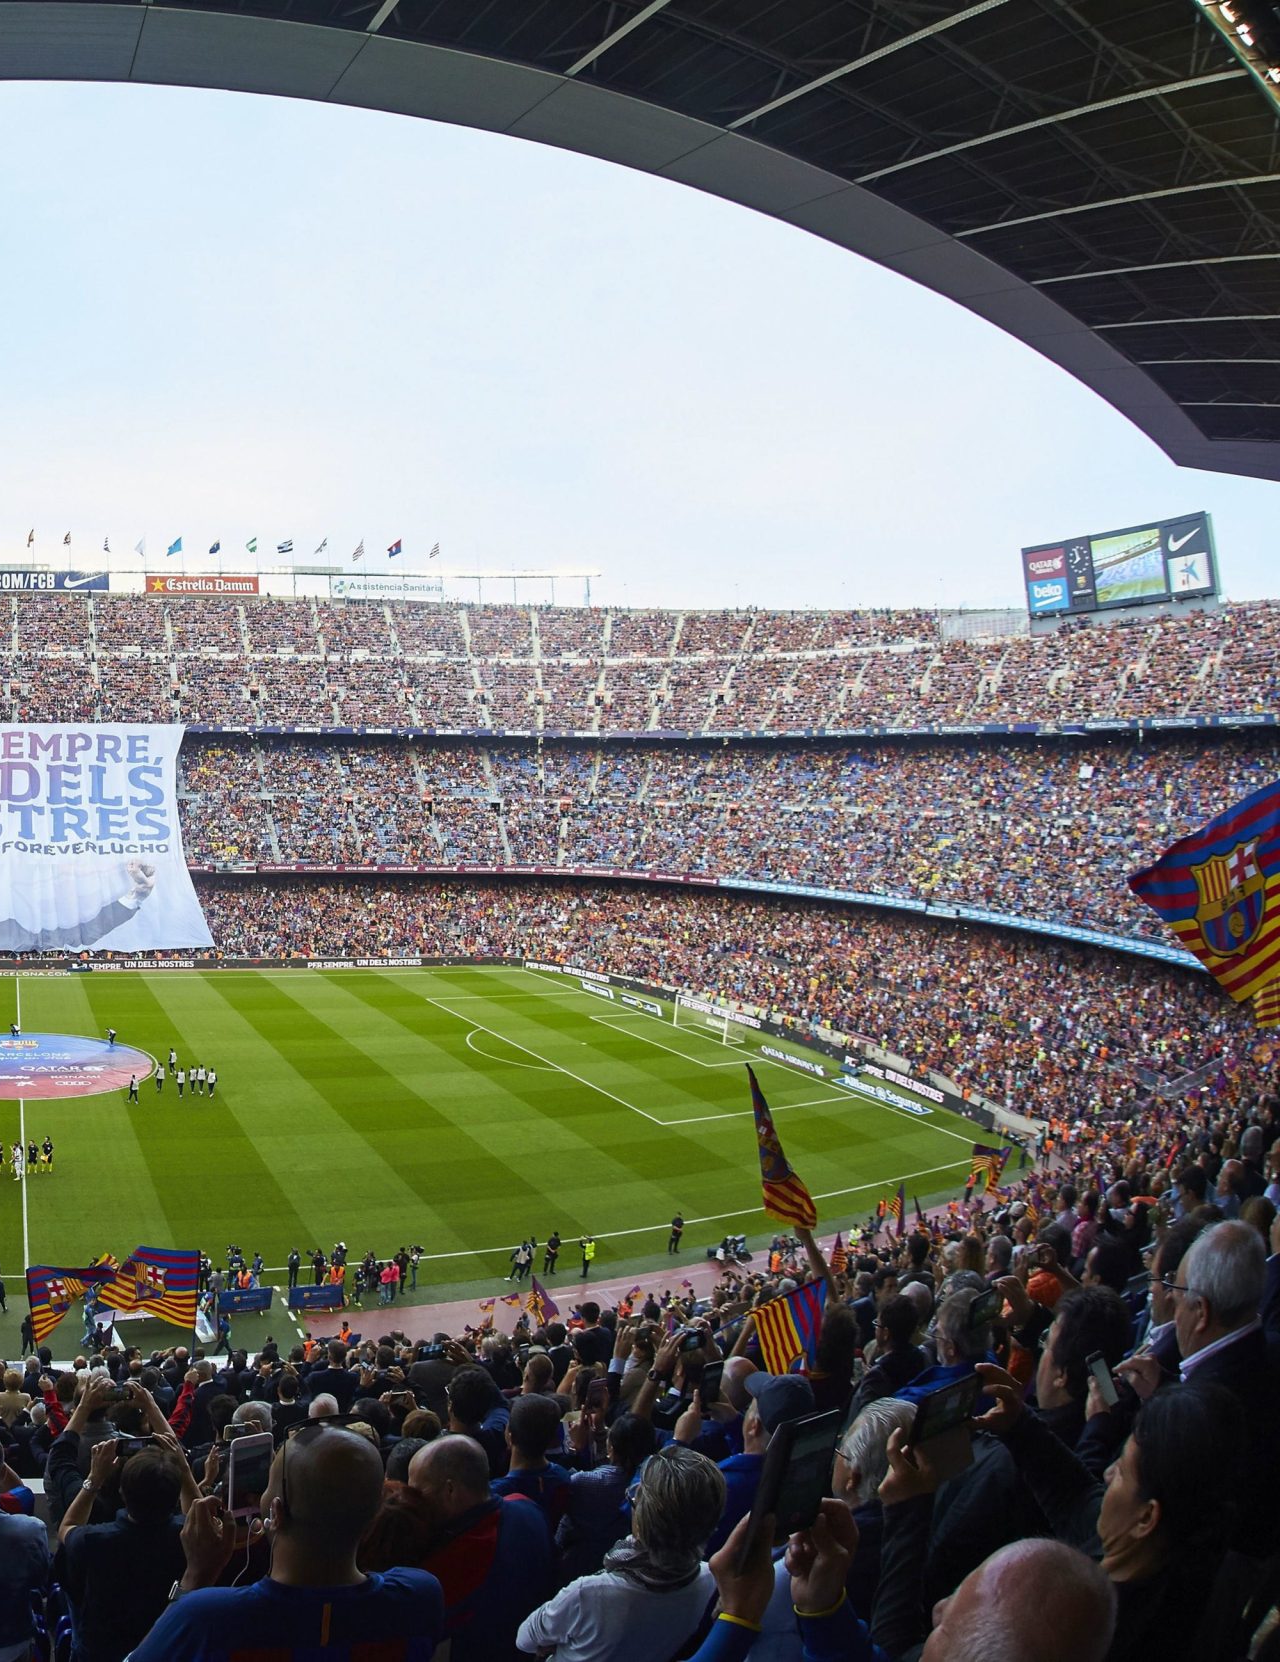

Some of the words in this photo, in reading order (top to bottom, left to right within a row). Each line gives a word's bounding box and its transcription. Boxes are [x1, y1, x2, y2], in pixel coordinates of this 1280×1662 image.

[1029, 558, 1054, 571] QATAR
[166, 577, 213, 591] Estrella
[214, 579, 254, 591] Damm
[1033, 584, 1062, 598] beko
[388, 958, 422, 966] NOSTRES
[761, 1045, 784, 1061] QATAR
[885, 1069, 895, 1081] UN
[912, 1080, 945, 1103] NOSTRES
[844, 1075, 876, 1095] Allianz
[886, 1089, 924, 1113] Seguros
